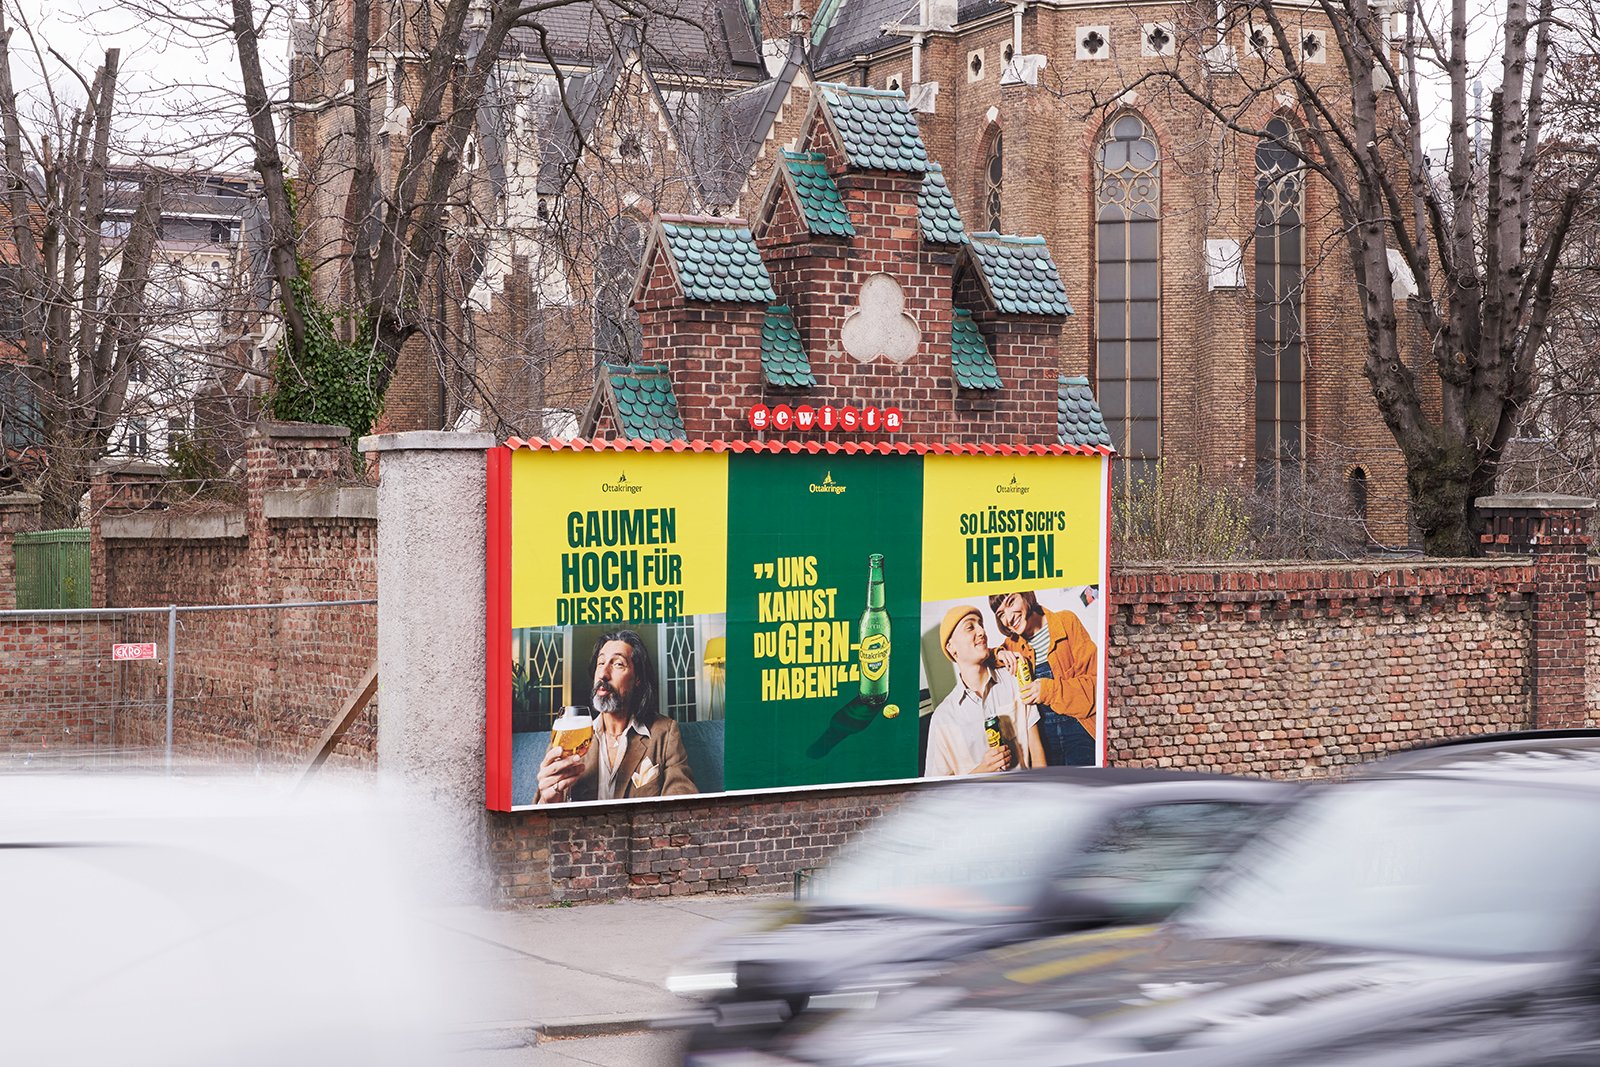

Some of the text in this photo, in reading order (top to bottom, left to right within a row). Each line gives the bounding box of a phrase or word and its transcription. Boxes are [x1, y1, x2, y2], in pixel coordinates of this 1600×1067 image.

[753, 407, 900, 427] gewista
[602, 483, 642, 494] Ottakringer
[809, 483, 847, 494] Ottakringer
[996, 484, 1030, 495] Ottakringer
[567, 507, 676, 548] GAUMEN
[960, 513, 977, 535] SO
[980, 506, 1024, 534] LÄSST
[561, 548, 682, 594] HOCH FÜR
[966, 533, 1063, 584] HEBEN.
[556, 590, 684, 626] DIESES BIER!
[758, 588, 838, 623] KANNST
[753, 632, 777, 659] DU
